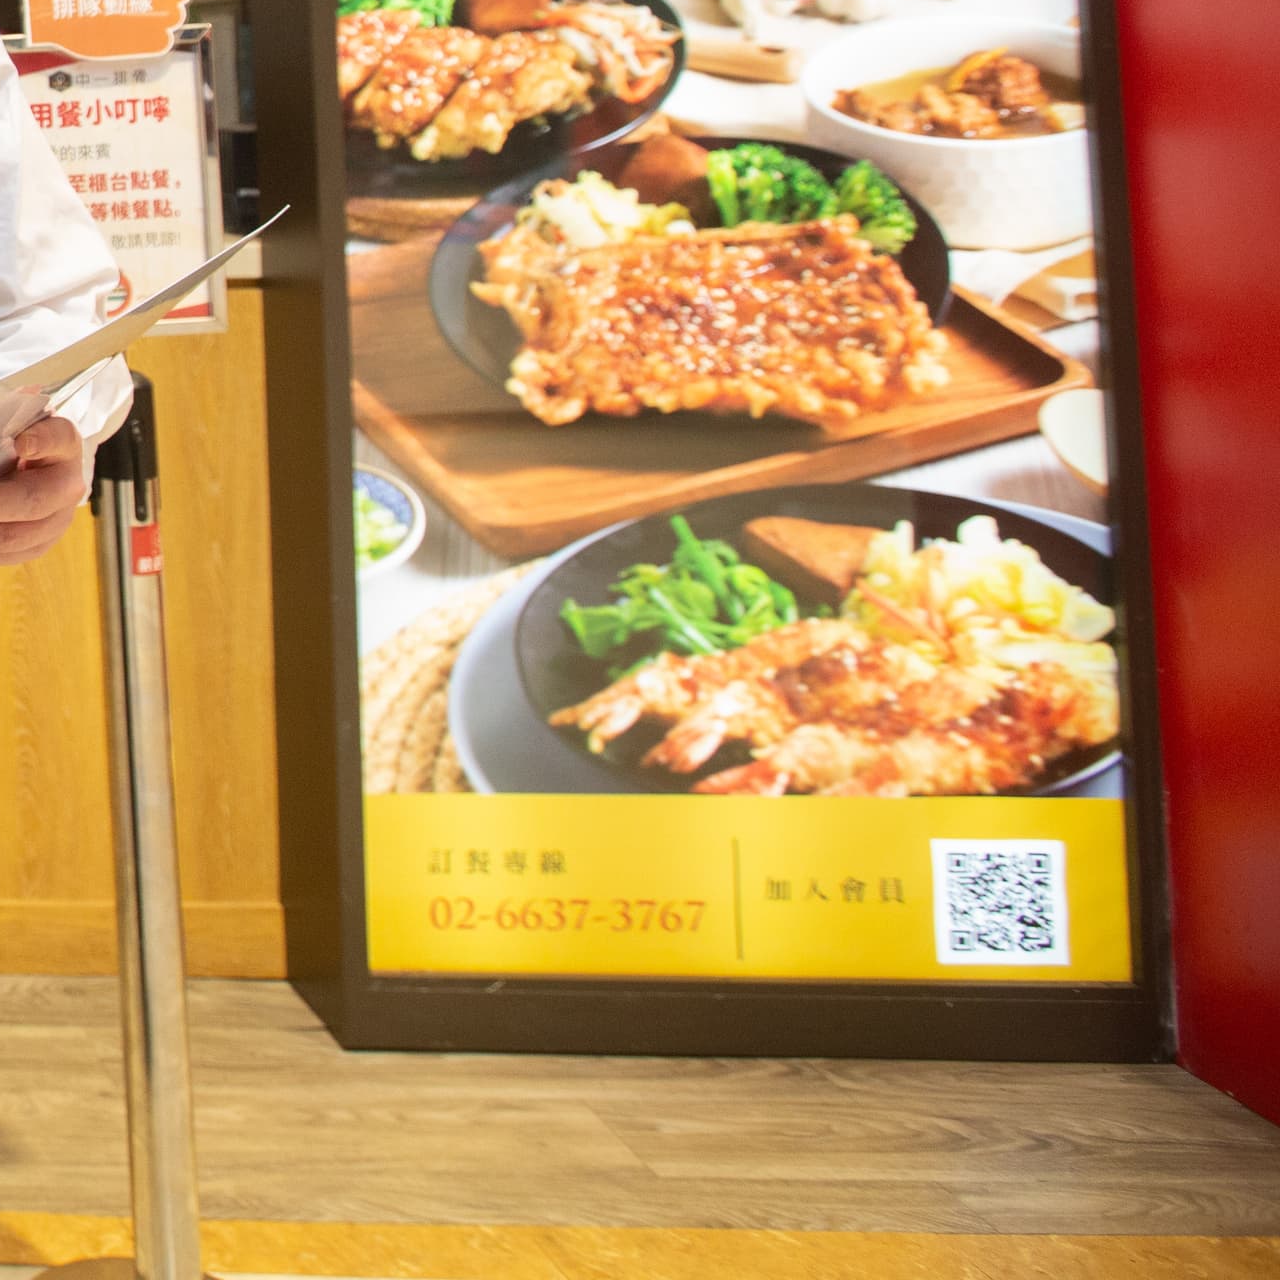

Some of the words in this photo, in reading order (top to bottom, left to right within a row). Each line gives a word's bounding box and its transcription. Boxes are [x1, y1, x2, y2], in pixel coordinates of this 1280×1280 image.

[30, 95, 171, 129] 用餐小叮嚀
[51, 142, 112, 162] 的來賓
[86, 198, 181, 222] 等候餐點。
[765, 876, 907, 904] 加入會員
[429, 895, 706, 933] 02-6637-3767
